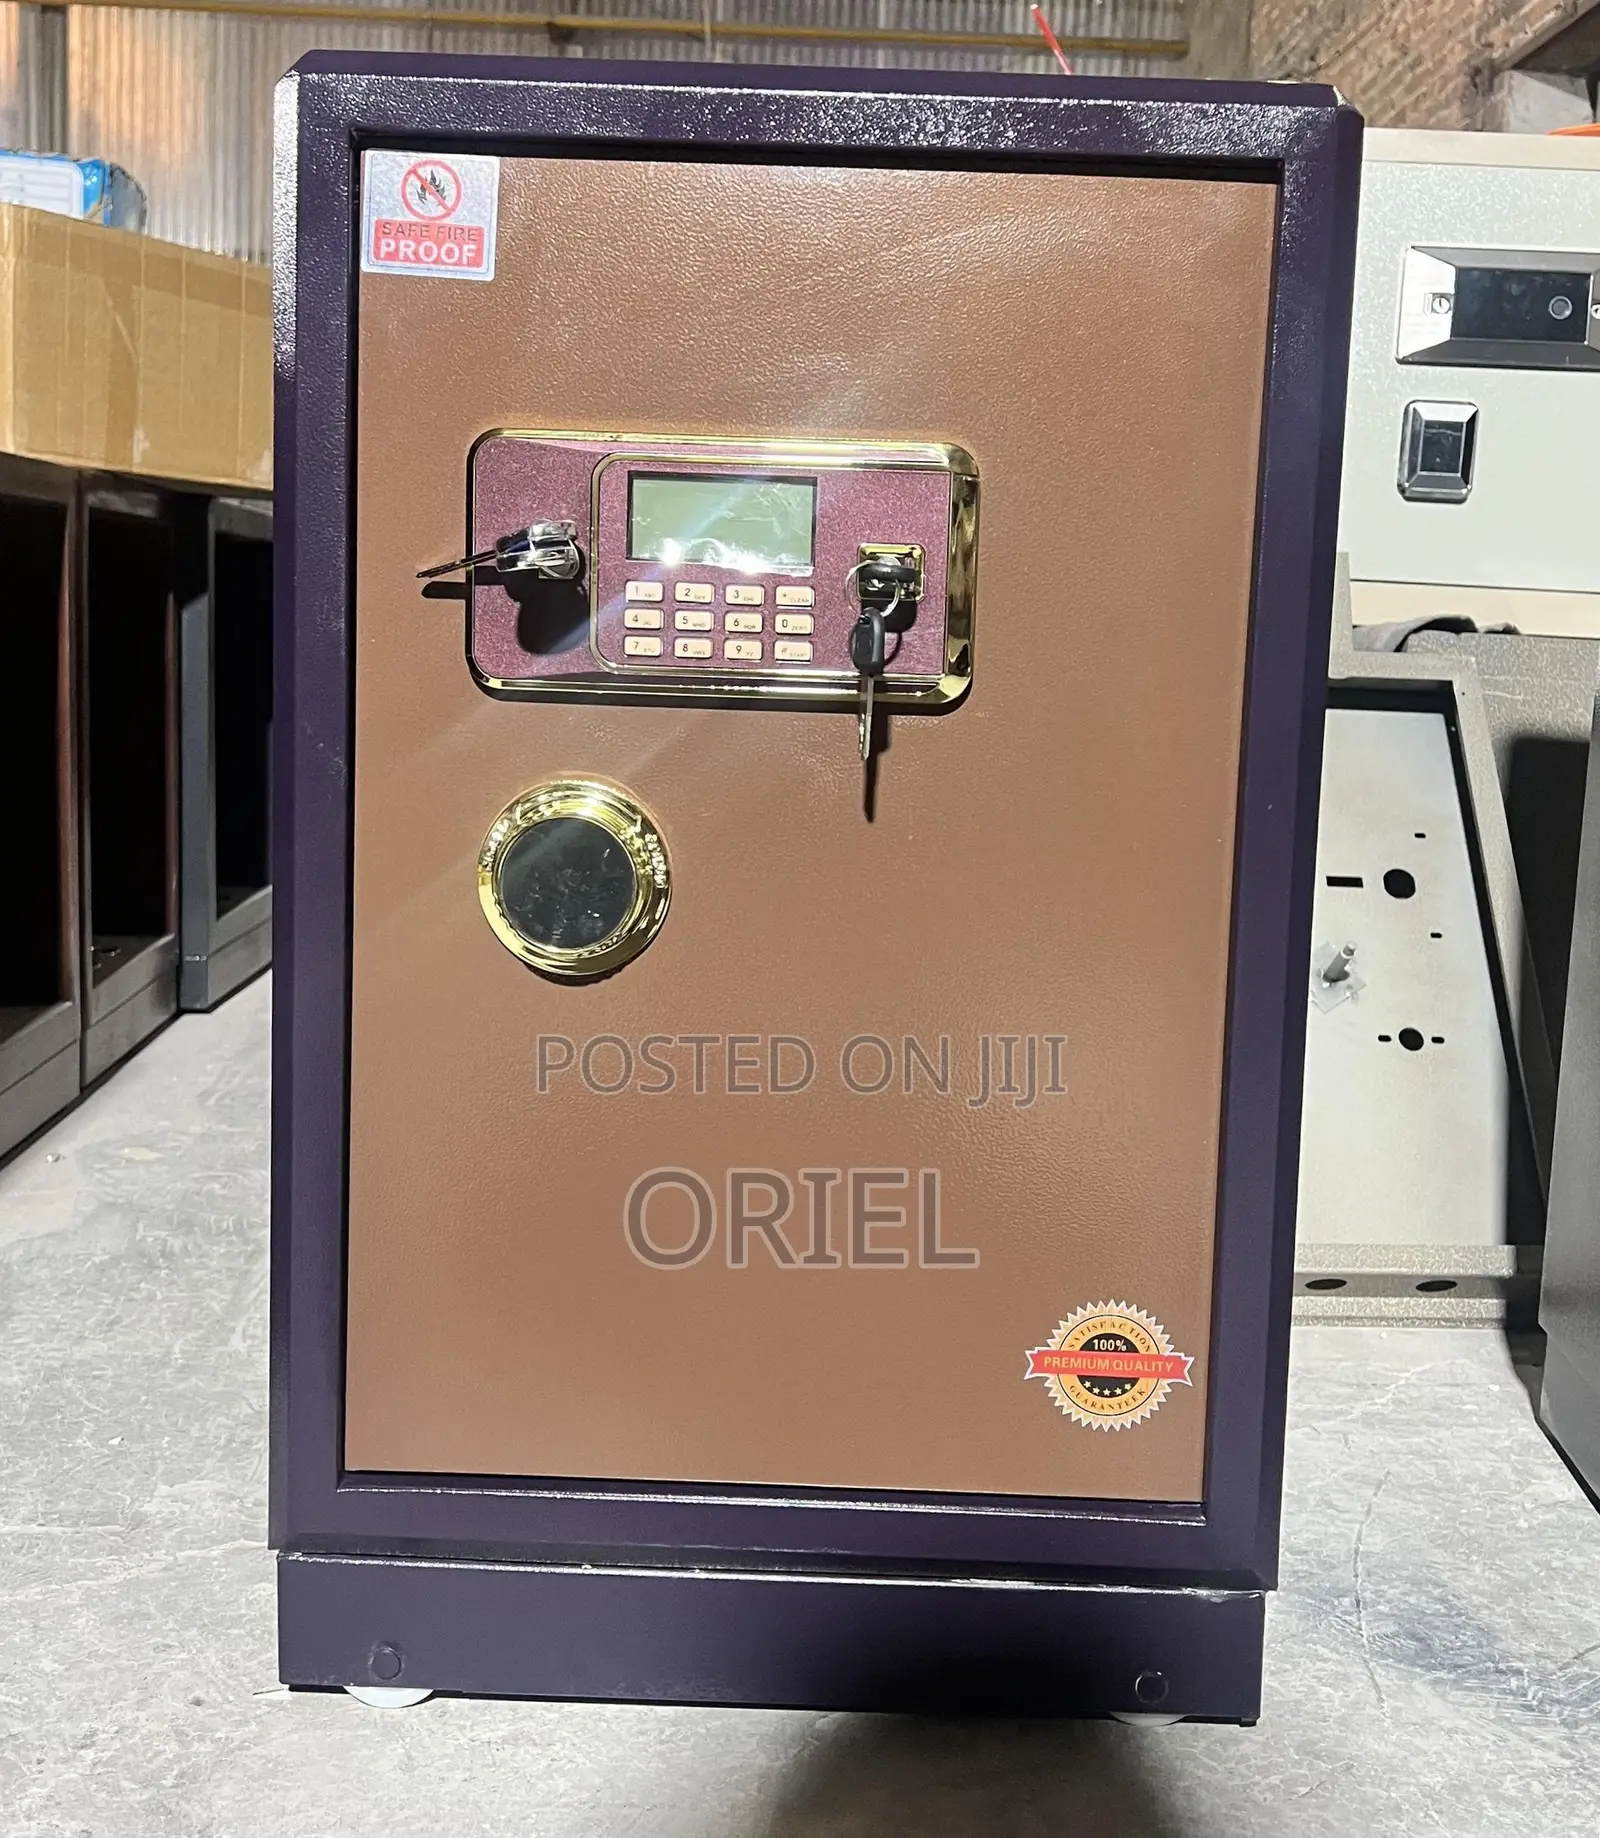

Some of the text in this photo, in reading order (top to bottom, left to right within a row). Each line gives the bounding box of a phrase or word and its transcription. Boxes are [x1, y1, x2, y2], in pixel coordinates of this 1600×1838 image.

[382, 221, 479, 242] SAFE FIRE
[380, 238, 478, 265] PROOF
[634, 586, 639, 597] 1
[684, 588, 691, 597] 2
[733, 589, 740, 599] 3
[632, 614, 639, 623] 4
[682, 616, 689, 625] 5
[733, 617, 739, 627] 6
[781, 618, 788, 628] 0
[633, 641, 640, 651] 7
[682, 643, 689, 652] 8
[735, 645, 742, 654] 9
[1068, 1321, 1152, 1352] SATISFACTION
[1092, 1338, 1127, 1352] 100%
[1044, 1356, 1174, 1373] PREMIUM QUALITY
